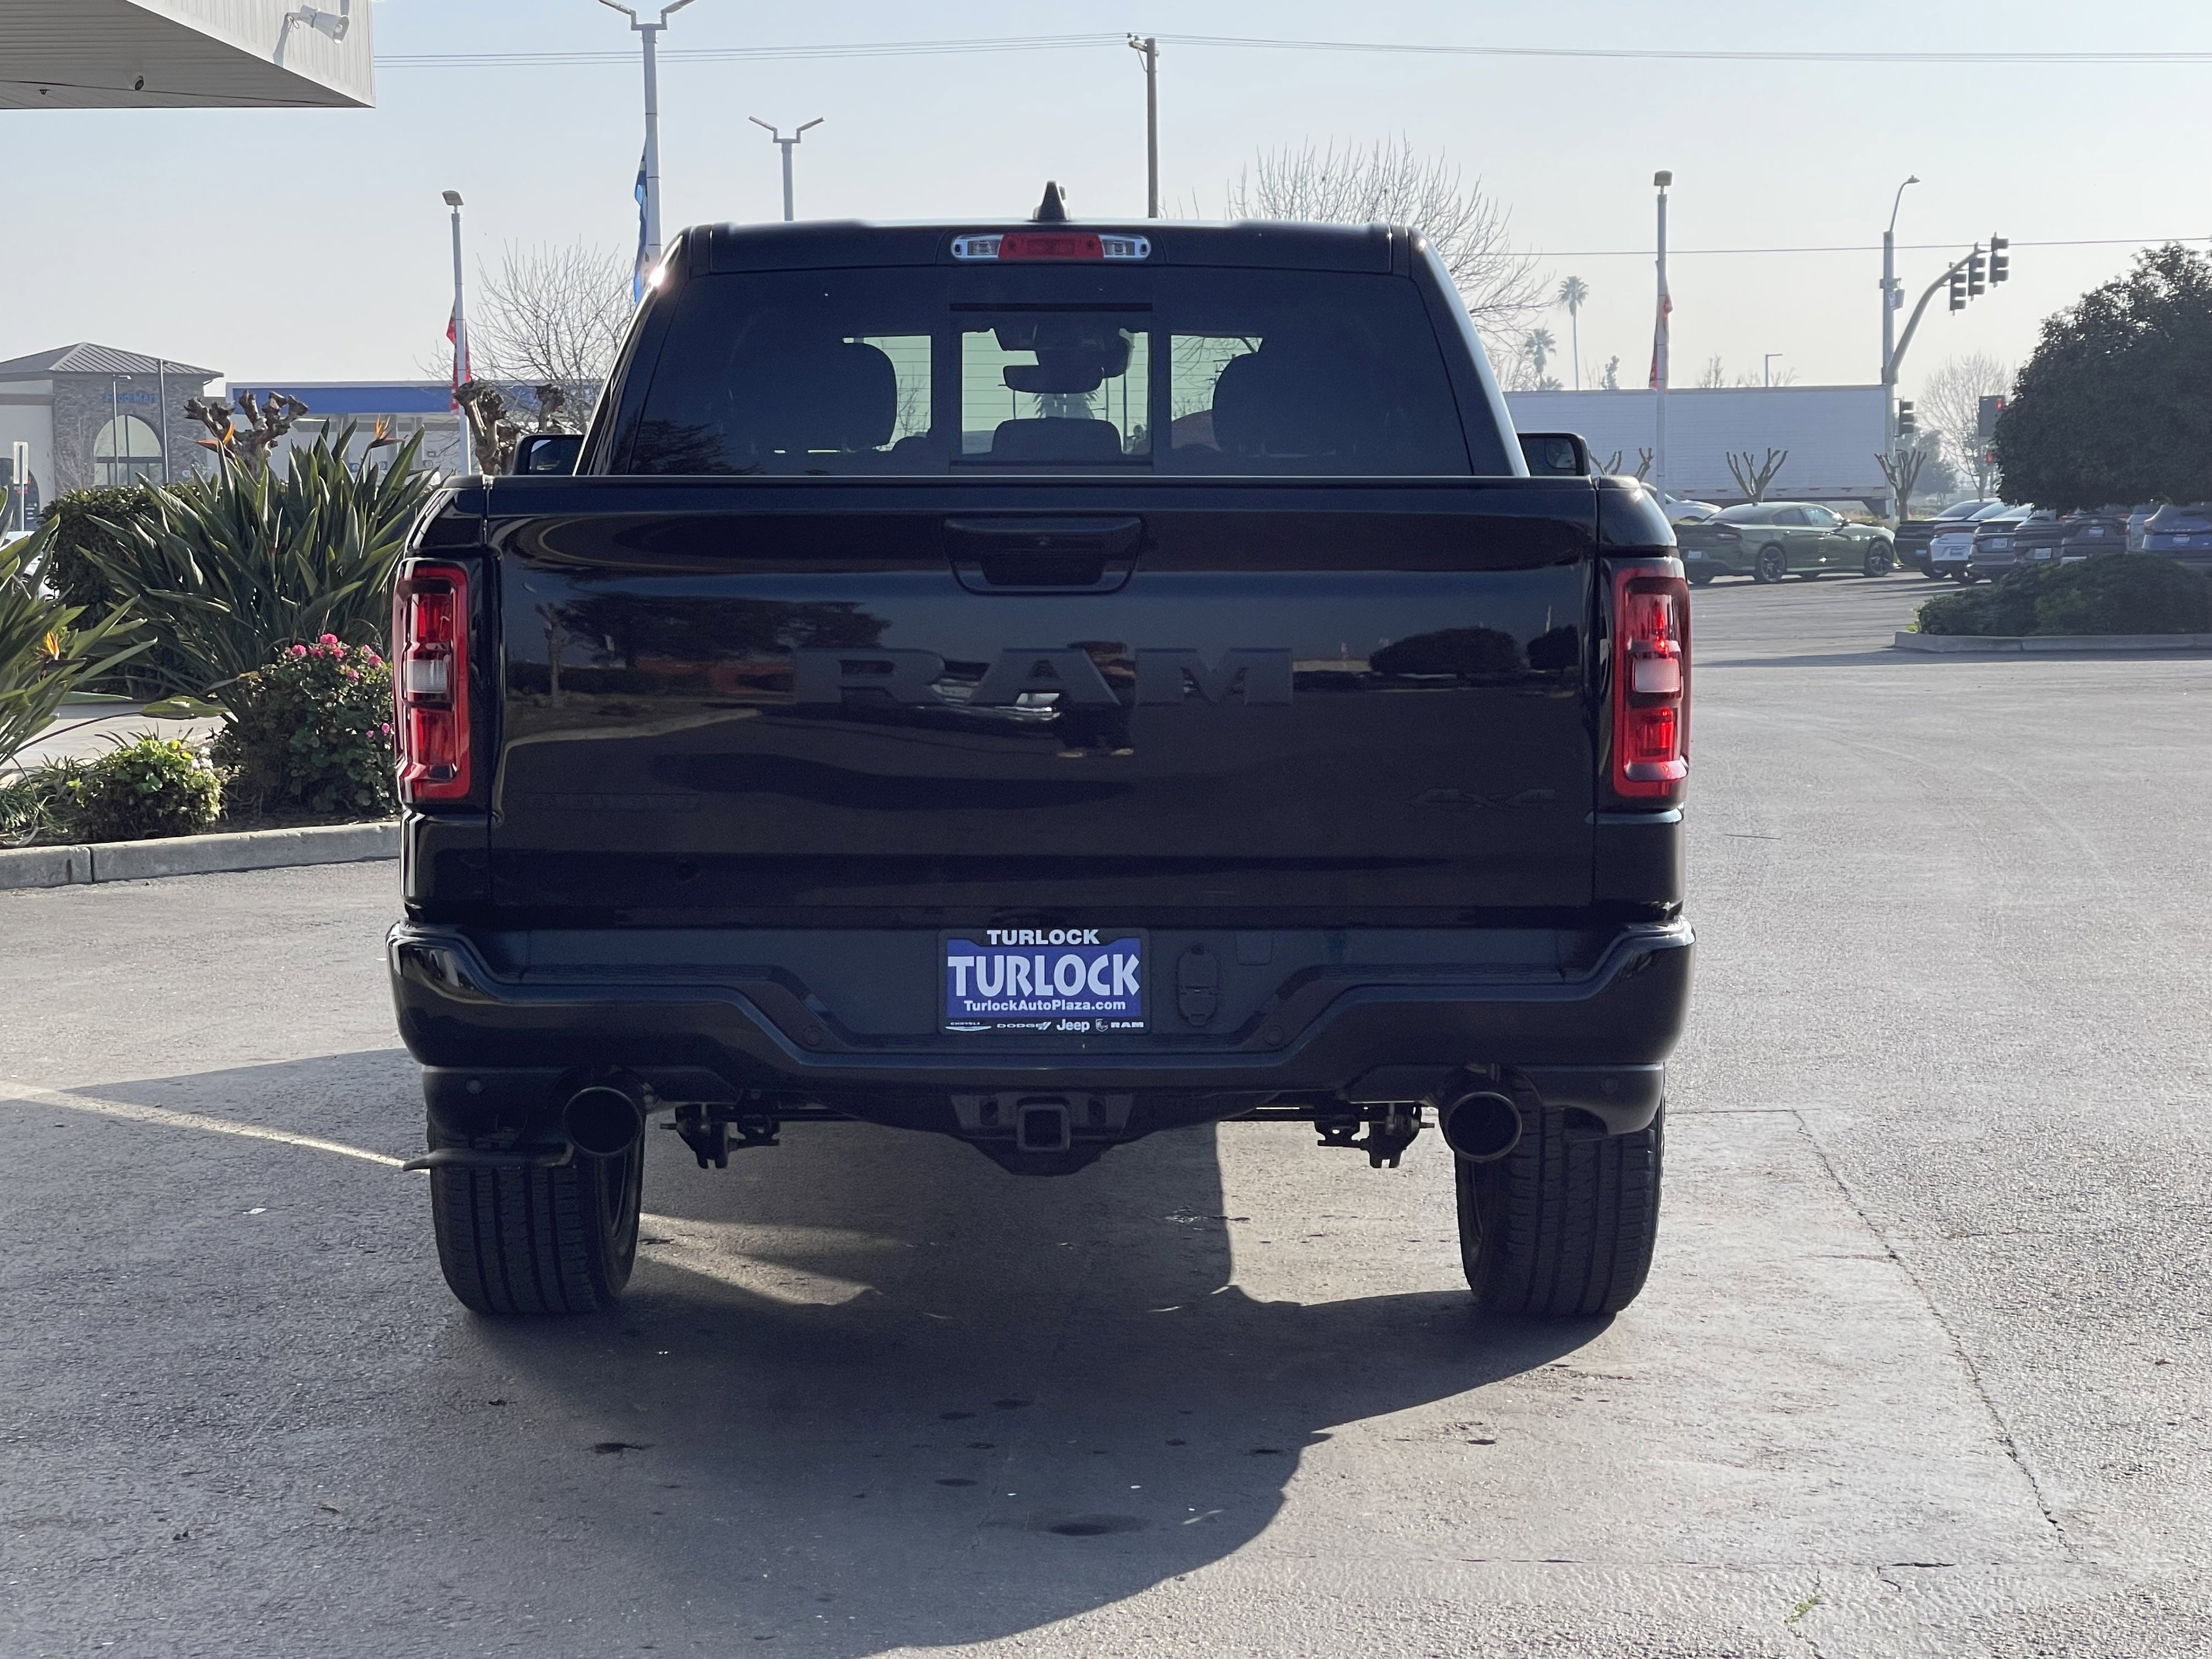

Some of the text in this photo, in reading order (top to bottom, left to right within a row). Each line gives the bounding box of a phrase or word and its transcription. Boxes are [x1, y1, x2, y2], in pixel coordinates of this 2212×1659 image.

[105, 392, 131, 402] Fod
[795, 647, 1293, 706] RAM
[986, 929, 1100, 945] TURLOCK
[947, 953, 1140, 997] TURLOCK
[963, 999, 1126, 1011] TurlockAutoPlaza.com
[1056, 1018, 1090, 1033] Jeep
